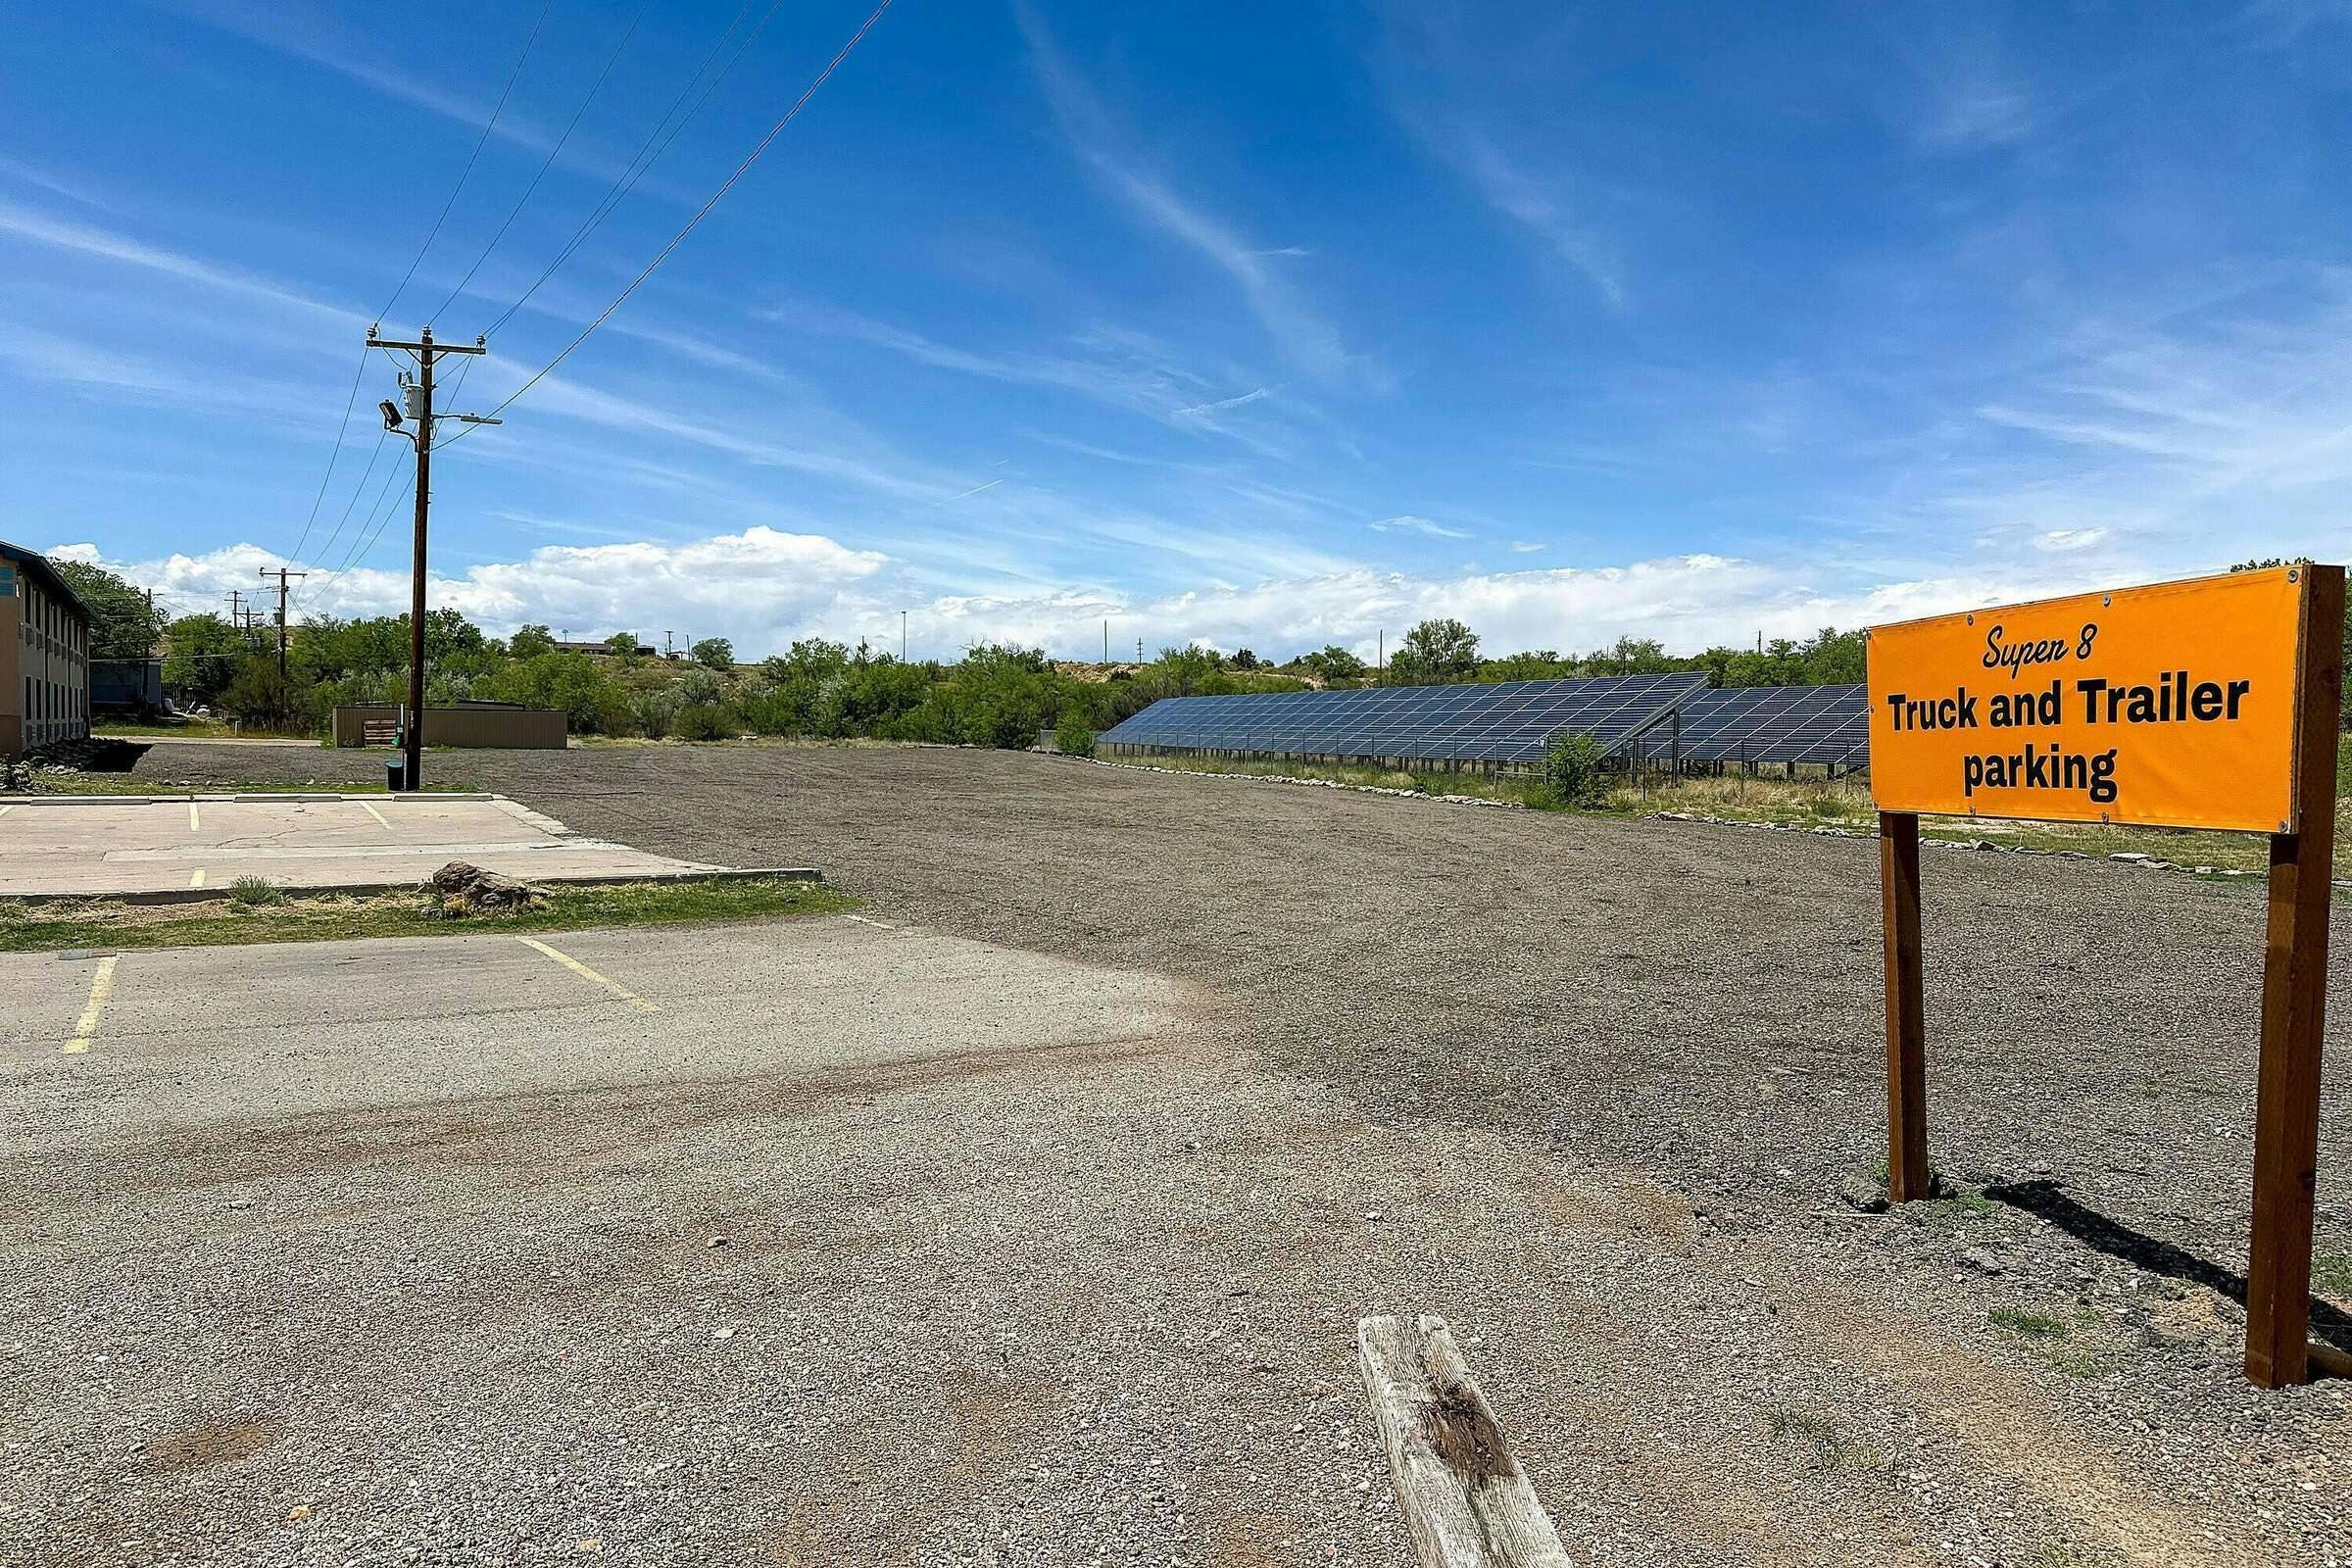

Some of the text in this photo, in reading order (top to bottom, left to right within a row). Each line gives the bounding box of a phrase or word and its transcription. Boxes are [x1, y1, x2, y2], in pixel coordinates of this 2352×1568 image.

[1982, 622, 2099, 680] Super 8
[1886, 670, 2251, 732] Truck and Trailer
[1963, 742, 2119, 805] parking
